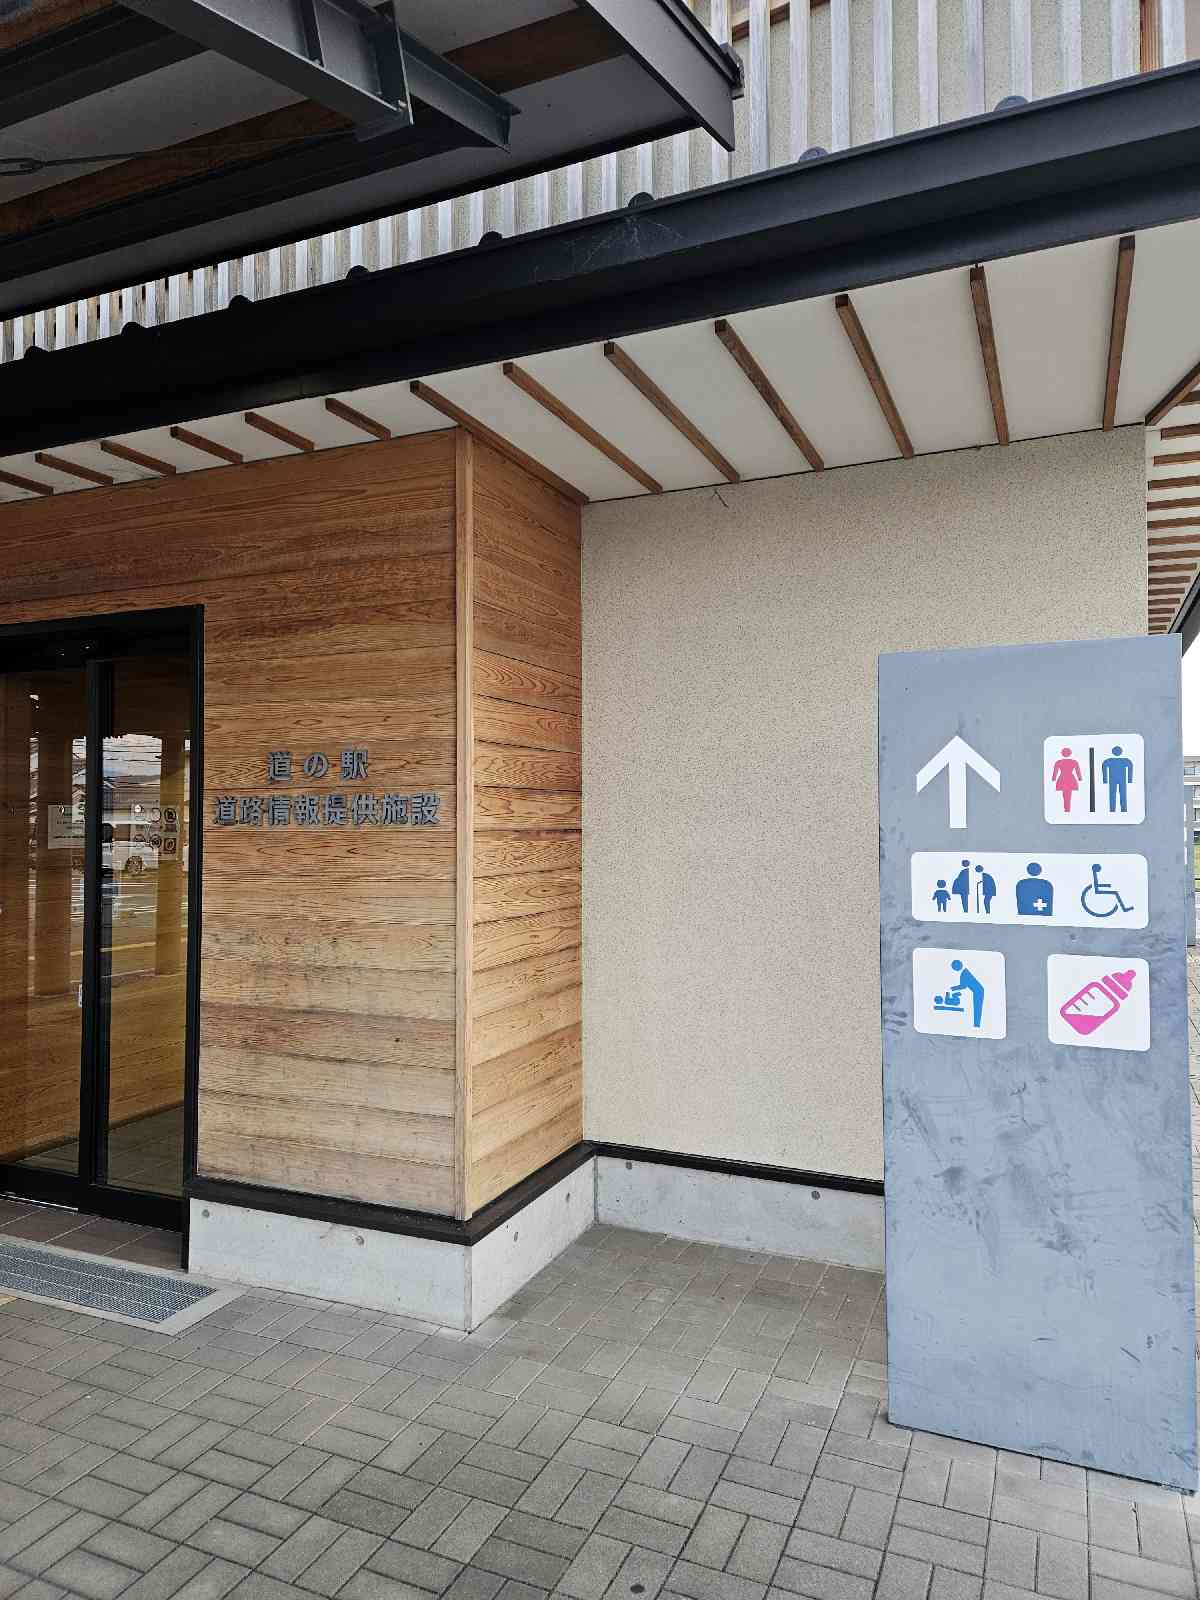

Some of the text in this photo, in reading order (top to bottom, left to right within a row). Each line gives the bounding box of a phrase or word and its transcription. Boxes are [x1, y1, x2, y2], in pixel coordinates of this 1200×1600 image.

[267, 749, 369, 784] 道の駅
[213, 794, 440, 826] 道路情報提供施設
